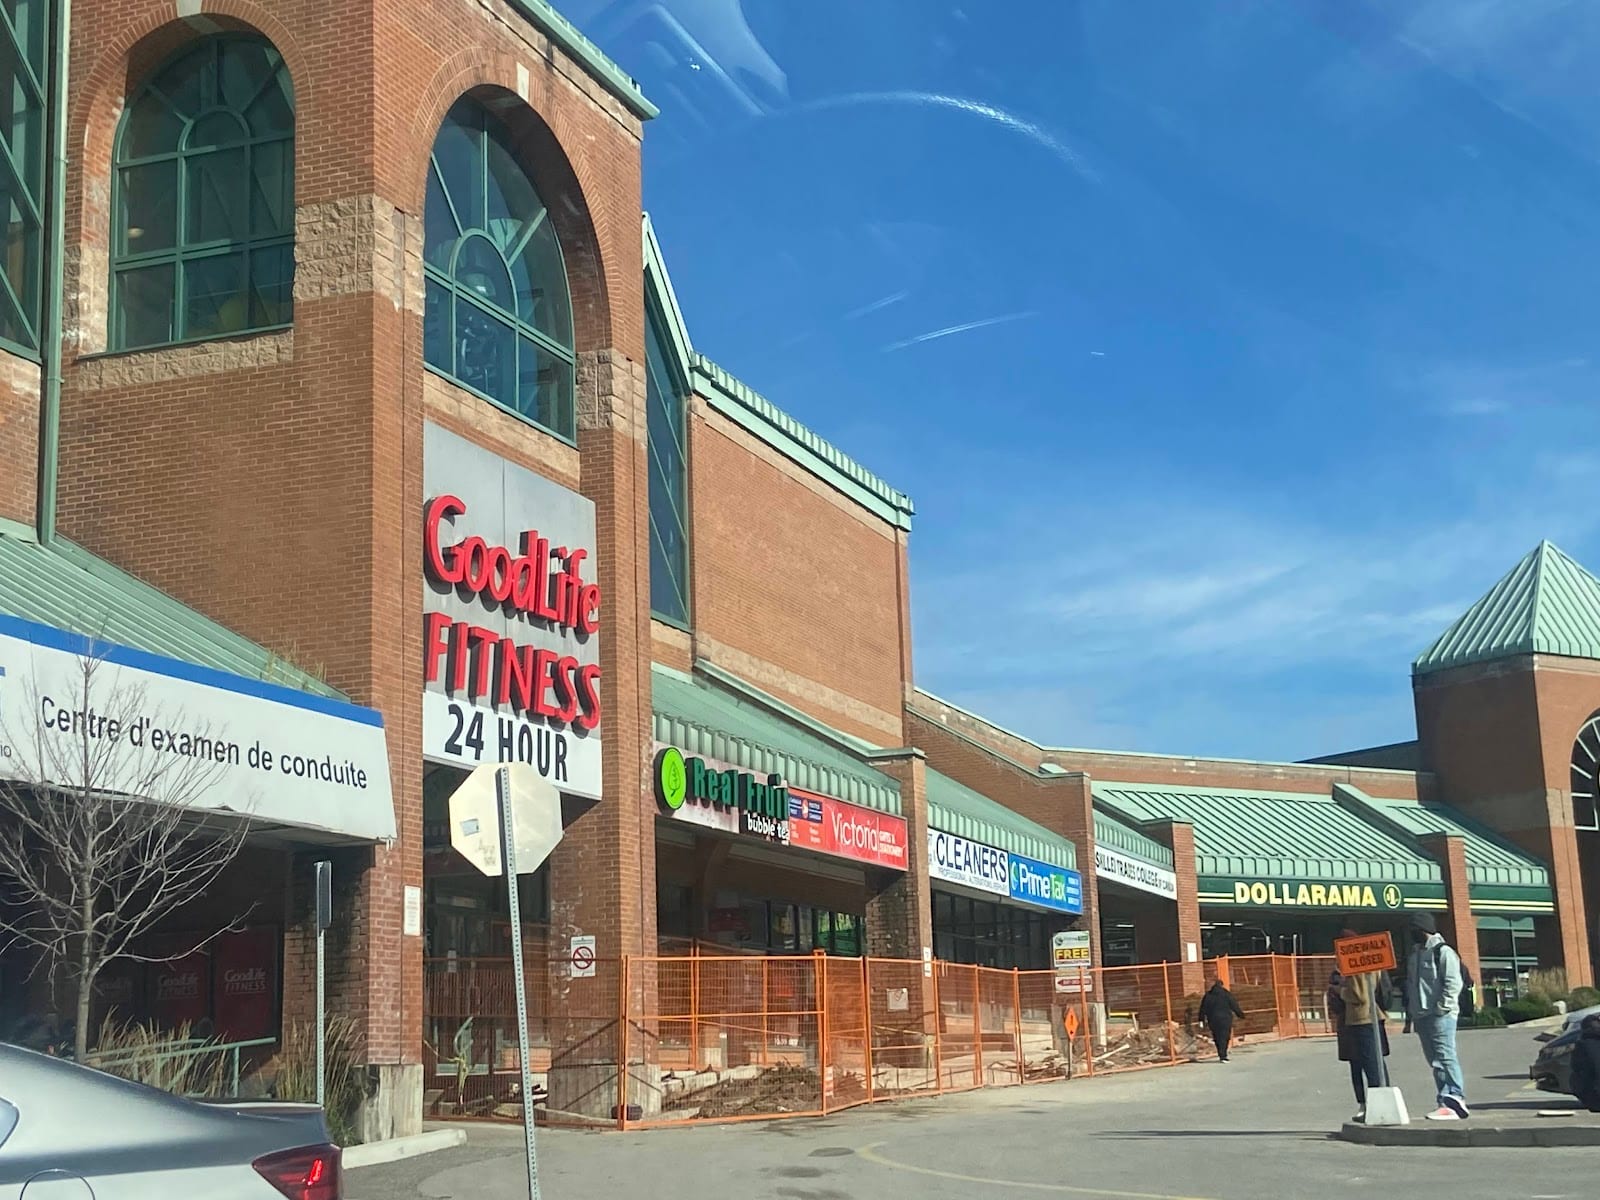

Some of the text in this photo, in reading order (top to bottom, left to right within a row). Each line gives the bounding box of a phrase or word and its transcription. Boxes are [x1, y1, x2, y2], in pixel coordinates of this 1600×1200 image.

[424, 494, 601, 635] GoodLife
[424, 611, 601, 730] FITNESS
[41, 695, 368, 790] Centre d'examen de conduite
[444, 703, 568, 783] 24 HOUR
[689, 757, 739, 807] Real
[747, 813, 776, 837] bubble
[777, 822, 790, 840] tea
[831, 810, 878, 852] Victoria
[936, 833, 1007, 883] CLEANERS
[1234, 881, 1378, 907] DOLLARAMA
[1055, 948, 1090, 960] FREE
[1339, 940, 1387, 956] SIDEWALK
[1348, 954, 1384, 969] CLOSED
